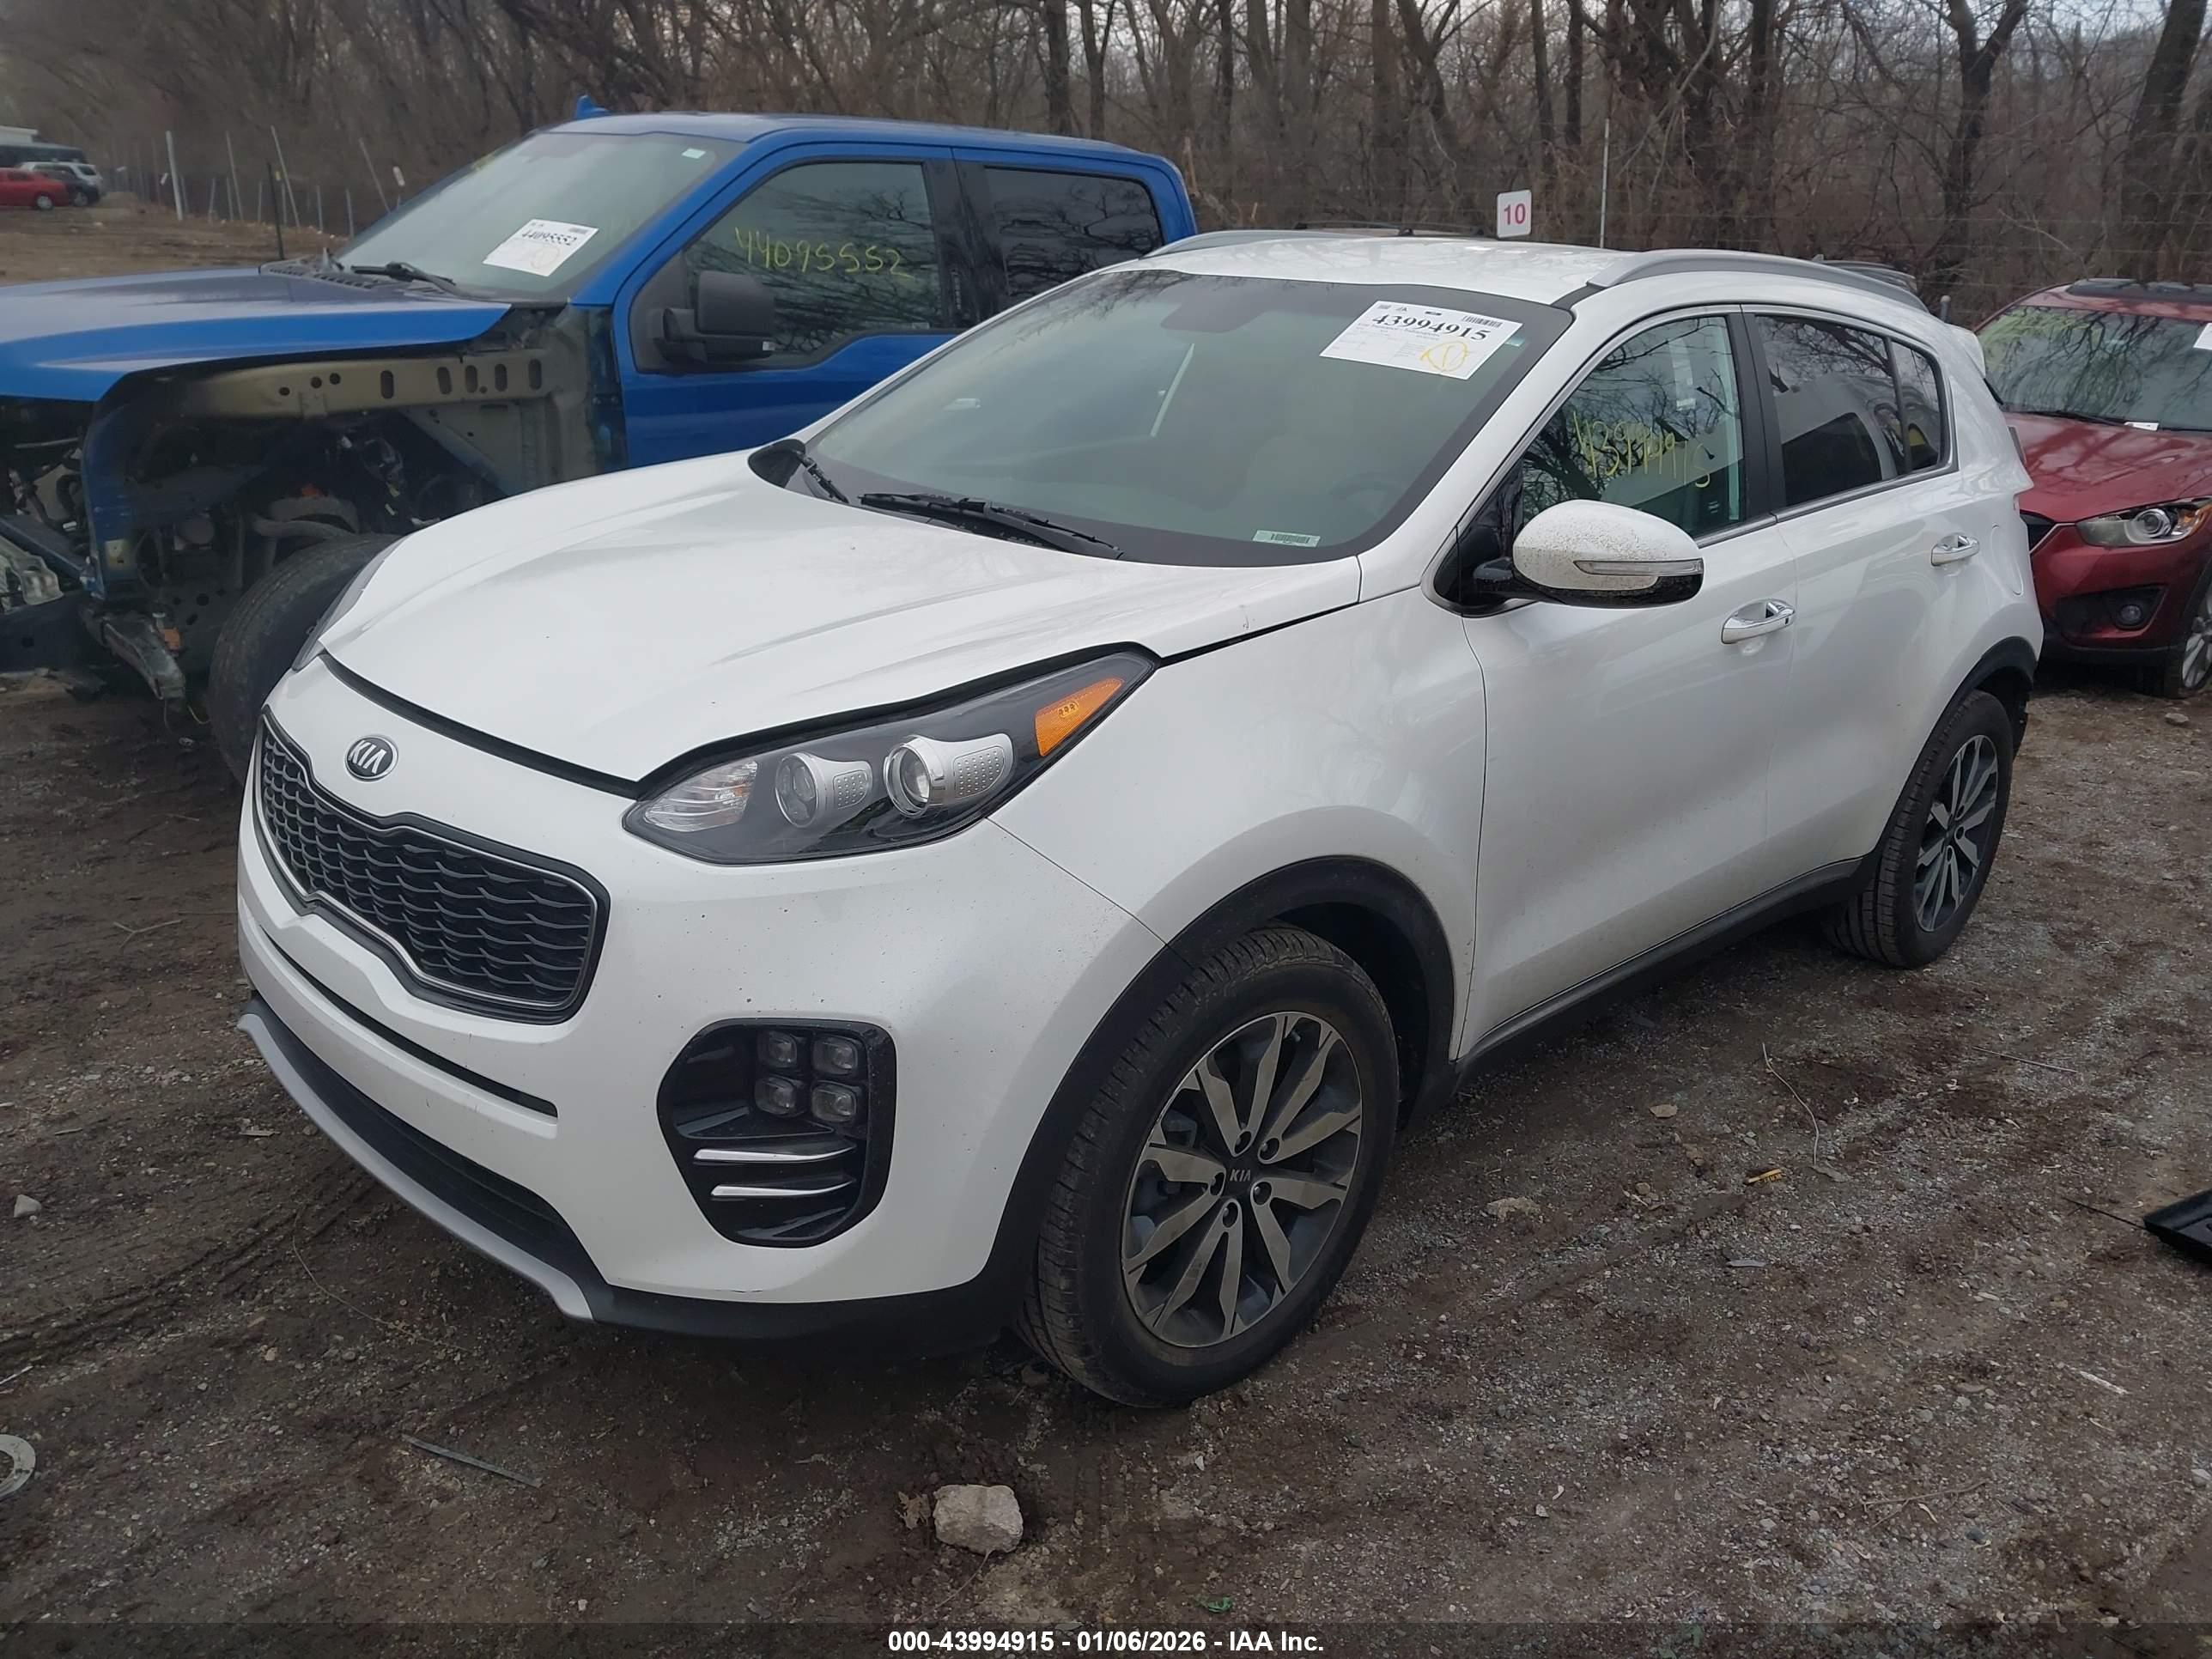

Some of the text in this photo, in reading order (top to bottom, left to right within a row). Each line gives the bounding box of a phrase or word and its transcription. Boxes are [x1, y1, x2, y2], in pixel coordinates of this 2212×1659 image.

[1504, 203, 1527, 226] 10
[734, 227, 915, 279] 44095552
[1372, 313, 1492, 341] 43994915
[348, 739, 387, 775] KIA
[1229, 1169, 1251, 1182] KIA
